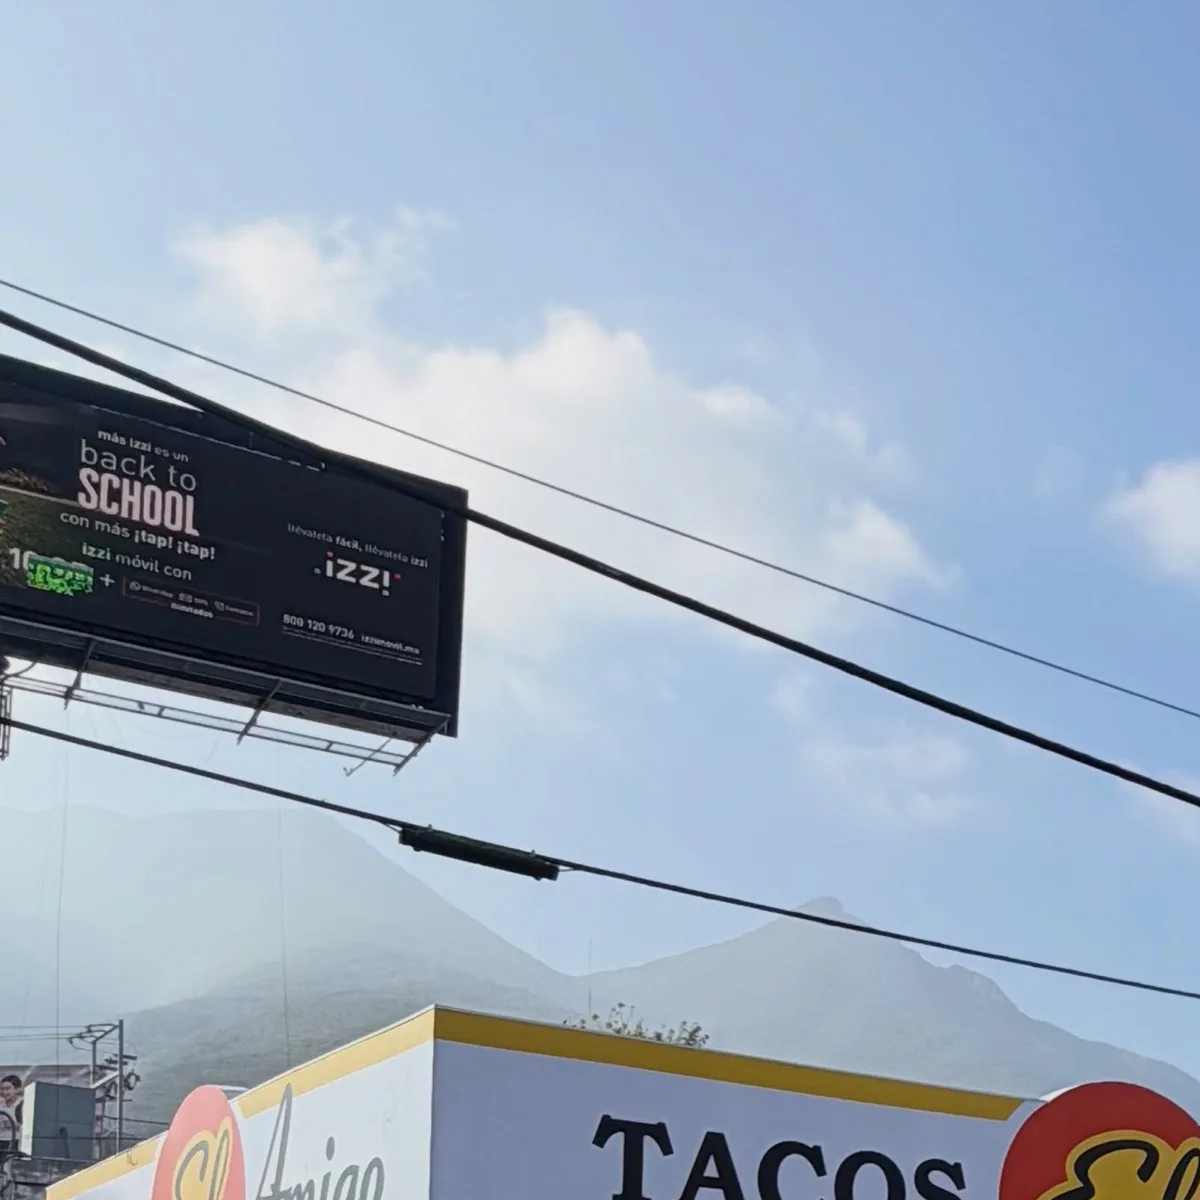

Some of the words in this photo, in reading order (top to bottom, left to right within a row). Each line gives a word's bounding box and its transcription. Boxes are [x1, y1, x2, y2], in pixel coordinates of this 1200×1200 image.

[81, 438, 156, 481] back
[168, 464, 197, 492] to
[97, 430, 127, 446] más
[129, 437, 152, 453] izzi
[154, 446, 170, 458] es
[172, 452, 189, 463] un
[78, 467, 200, 537] SCHOOL
[60, 511, 90, 528] con
[95, 519, 131, 538] más
[134, 529, 174, 550] ¡tap!
[177, 540, 216, 560] ¡tap!
[82, 542, 111, 561] izzi
[116, 553, 161, 573] móvil
[163, 565, 192, 581] con
[283, 613, 304, 628] 800
[306, 619, 326, 633] 120
[328, 624, 355, 640] 9736
